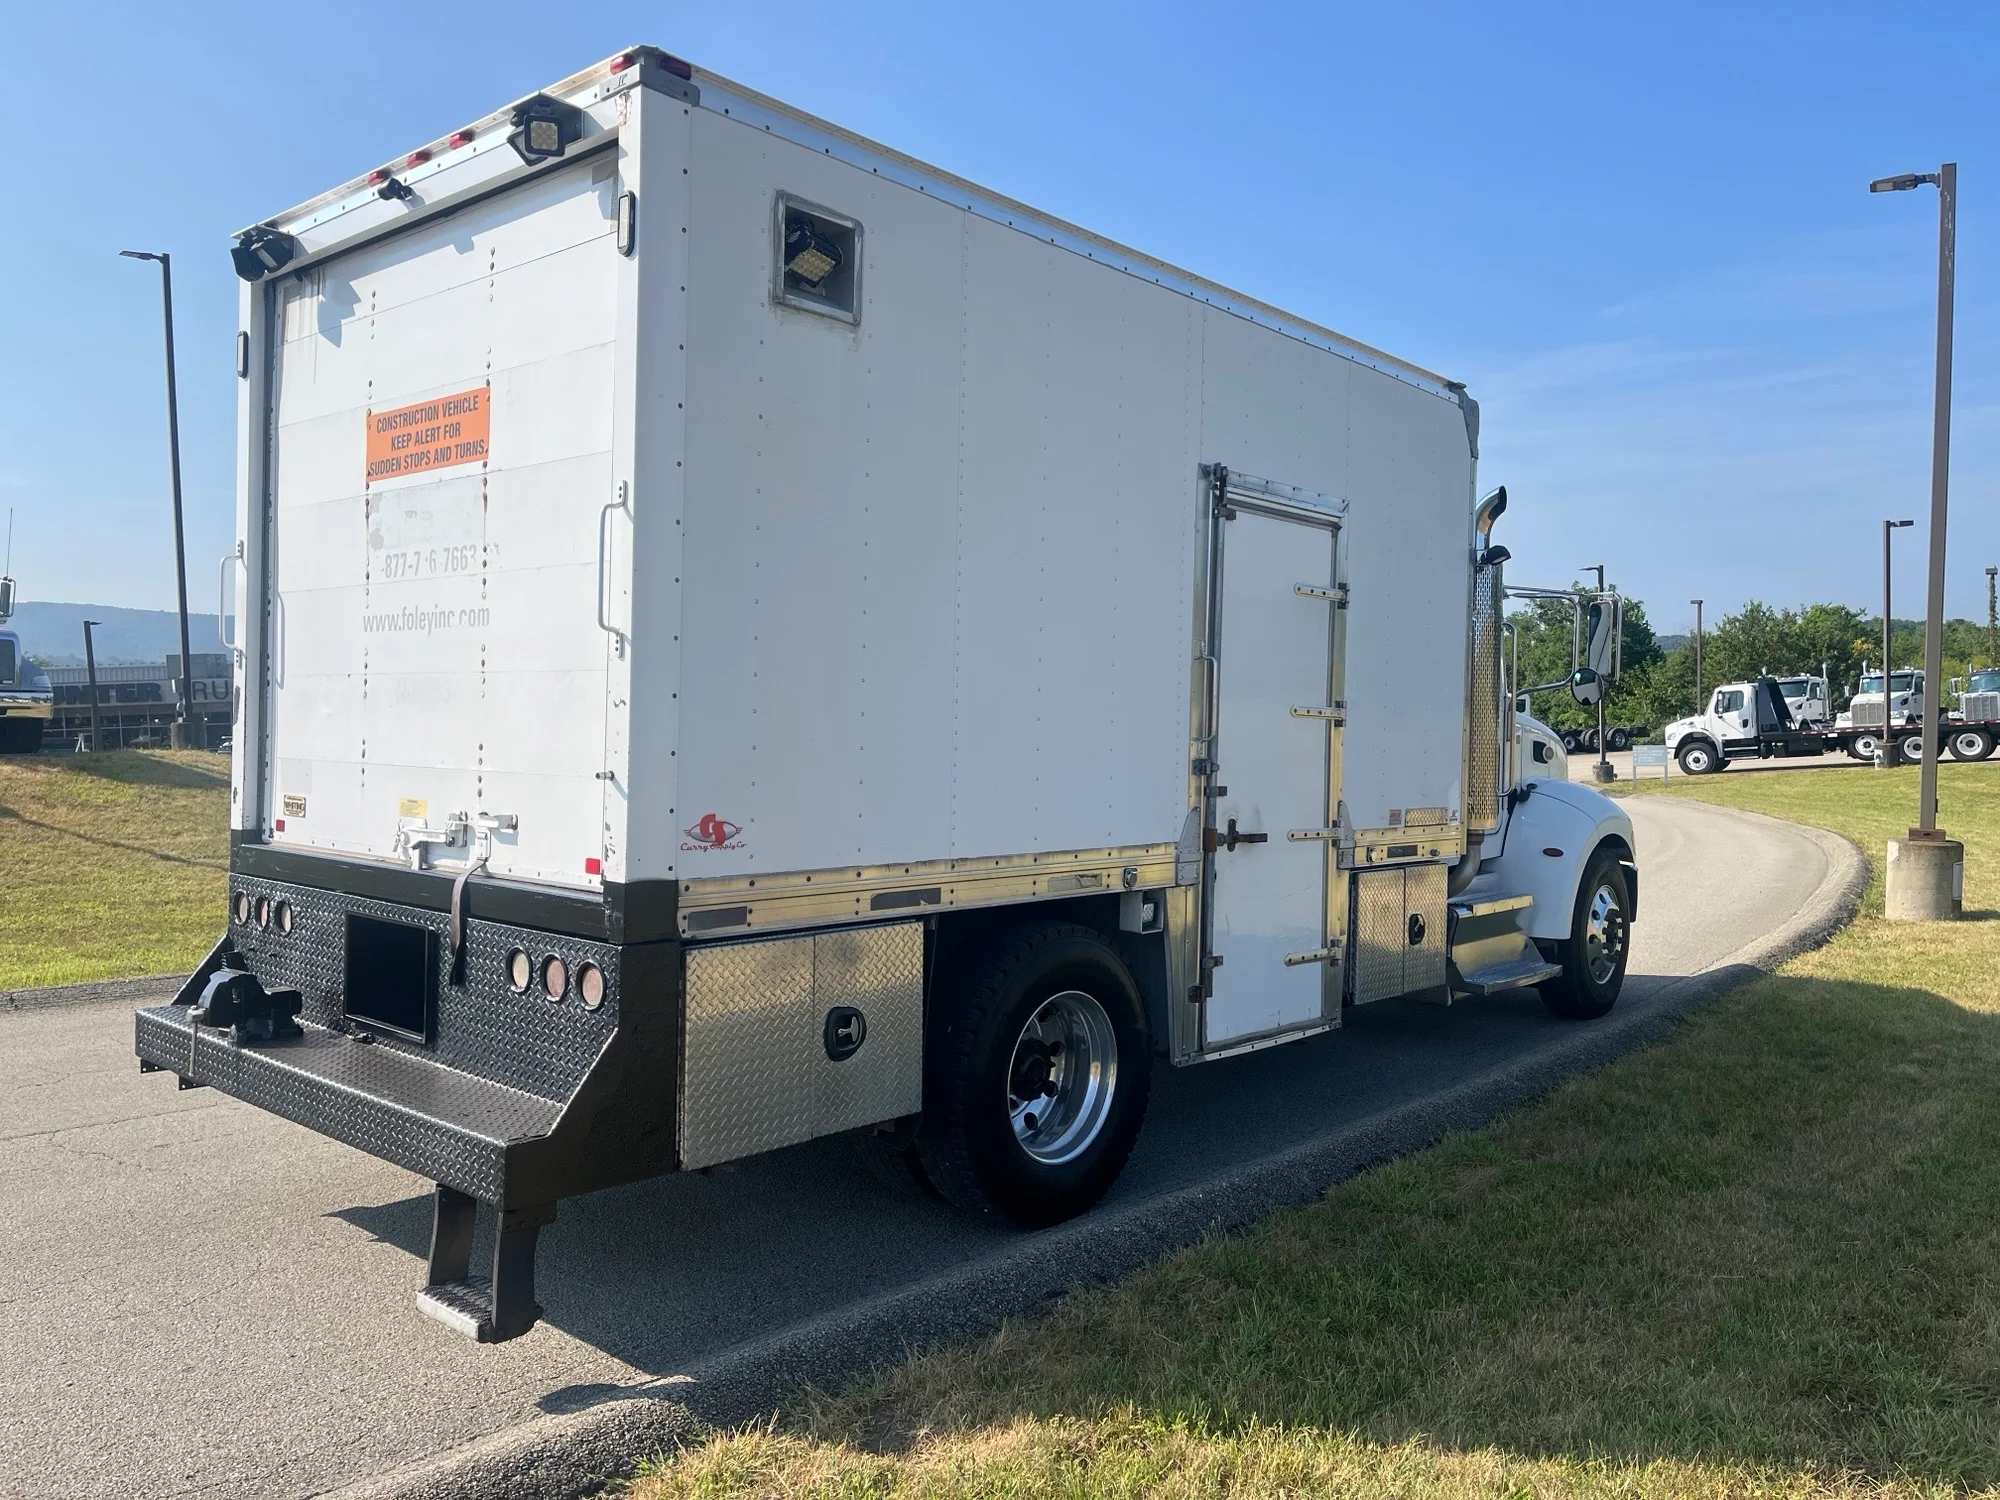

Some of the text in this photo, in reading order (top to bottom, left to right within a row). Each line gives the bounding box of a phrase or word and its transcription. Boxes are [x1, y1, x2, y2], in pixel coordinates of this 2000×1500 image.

[376, 395, 479, 433] CONSTRUCTION VEHICLE
[391, 422, 461, 451] KEEP ALERT FOR
[369, 439, 485, 477] SUDDEN STOPS AND TURNS
[53, 682, 163, 706] UNTER
[680, 842, 708, 852] Curry
